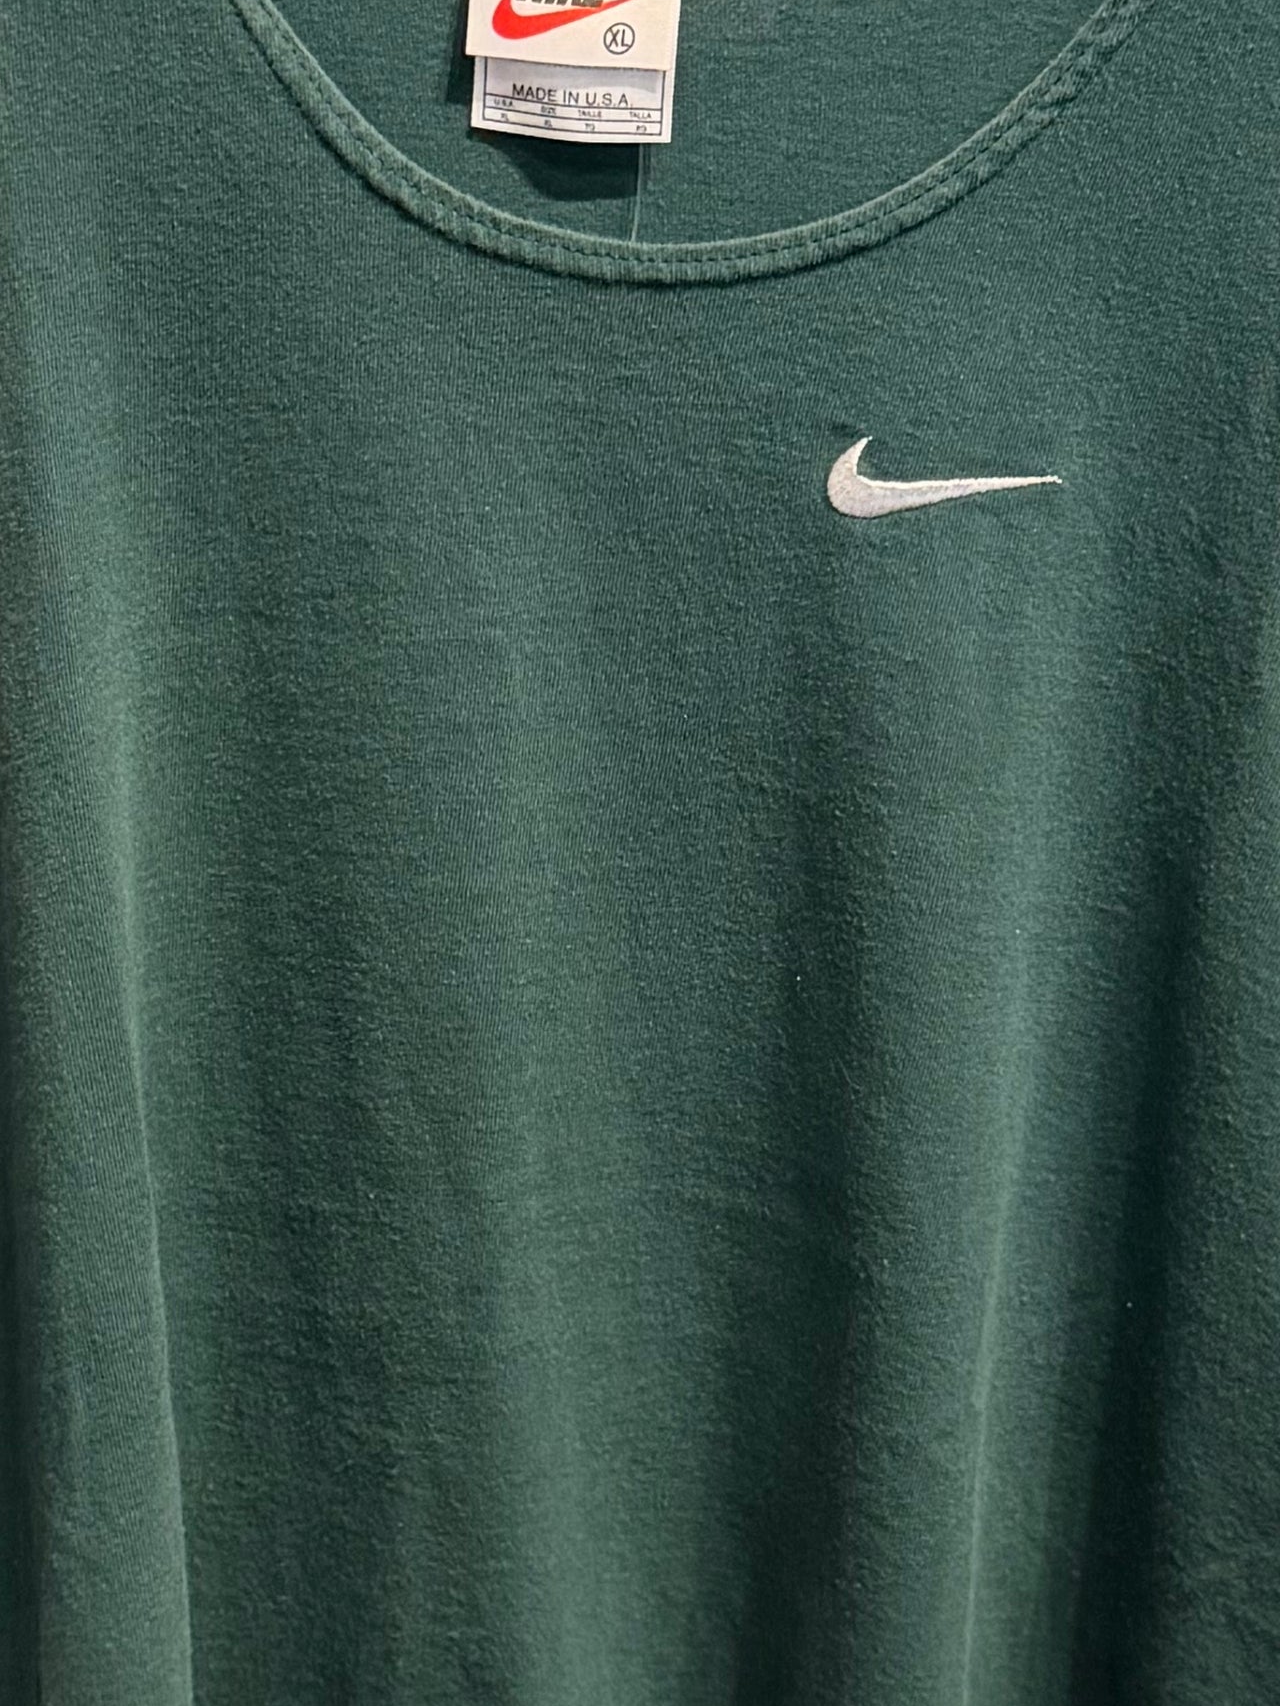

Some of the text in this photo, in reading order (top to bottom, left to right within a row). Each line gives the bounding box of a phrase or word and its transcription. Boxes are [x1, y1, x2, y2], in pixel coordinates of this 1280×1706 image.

[607, 28, 630, 47] XL
[512, 83, 633, 109] MADE IN U.S.A.
[629, 111, 652, 120] TALLA
